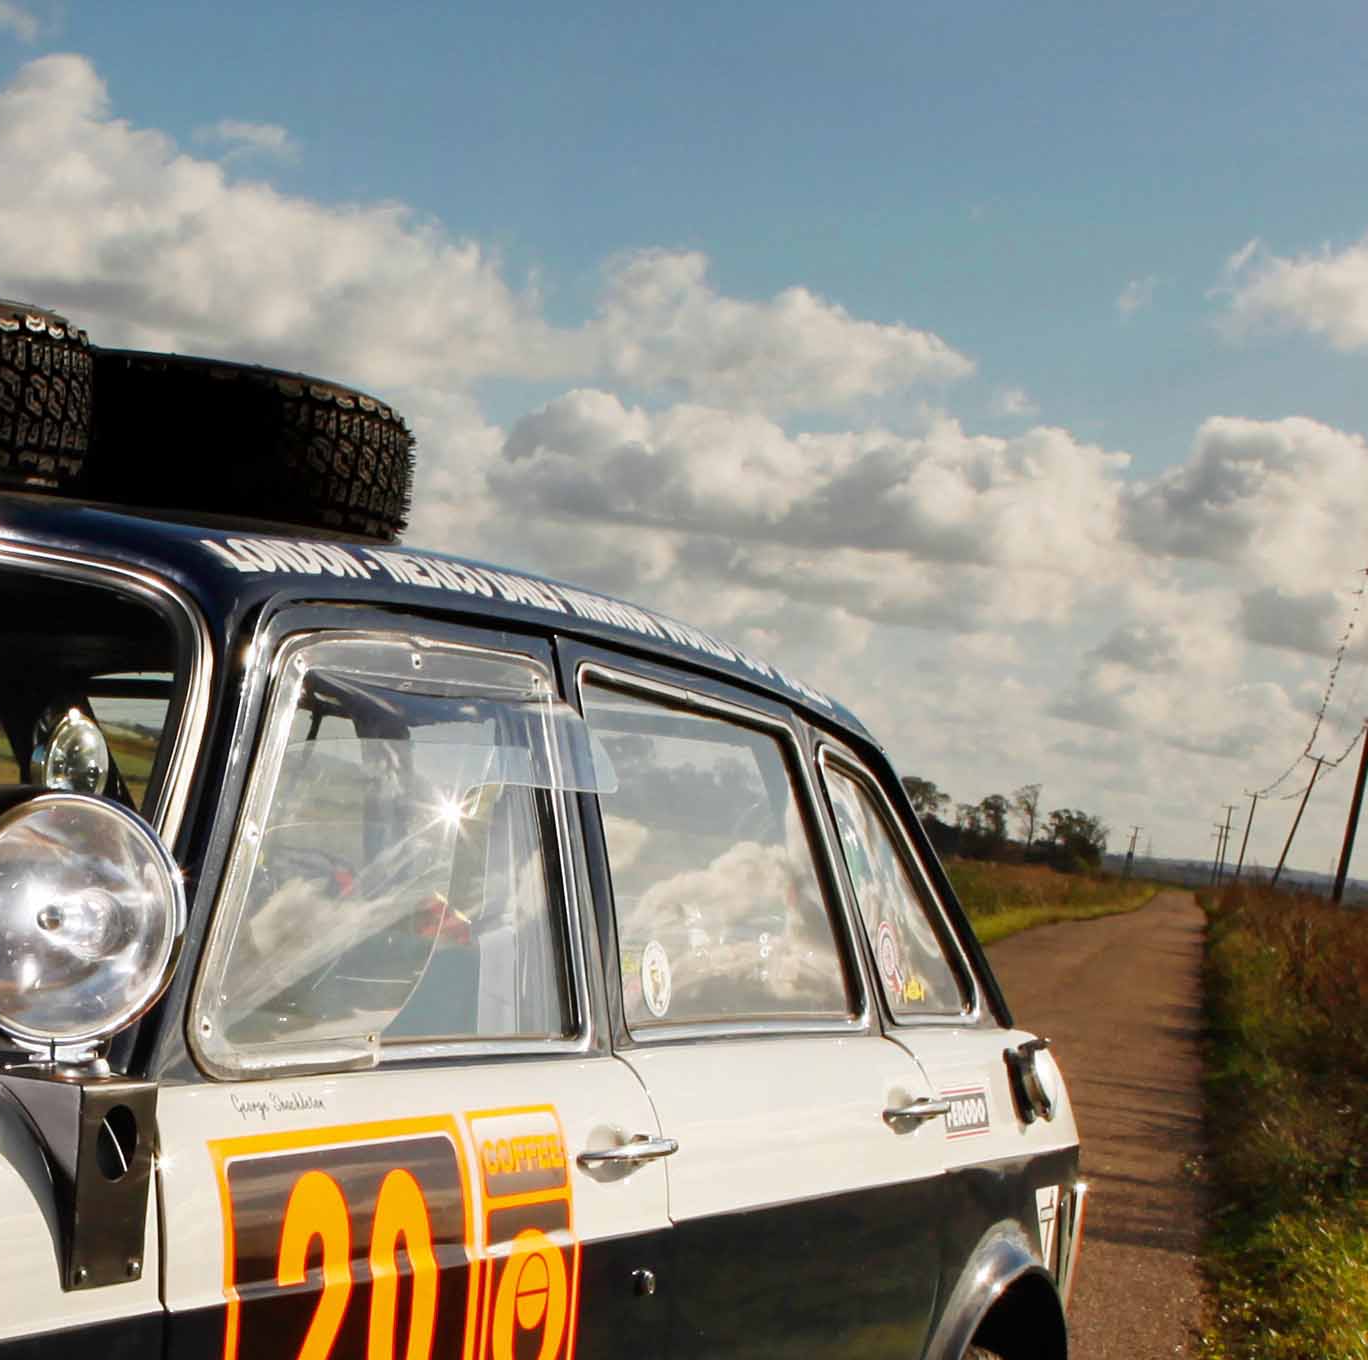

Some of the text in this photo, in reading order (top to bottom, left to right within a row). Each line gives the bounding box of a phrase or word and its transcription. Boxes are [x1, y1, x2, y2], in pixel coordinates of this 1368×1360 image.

[200, 538, 371, 580] LONDON
[361, 547, 494, 598] MEXICO
[474, 567, 568, 614] DAILY
[547, 583, 666, 640] MIRROR
[480, 1136, 563, 1176] COFFEE
